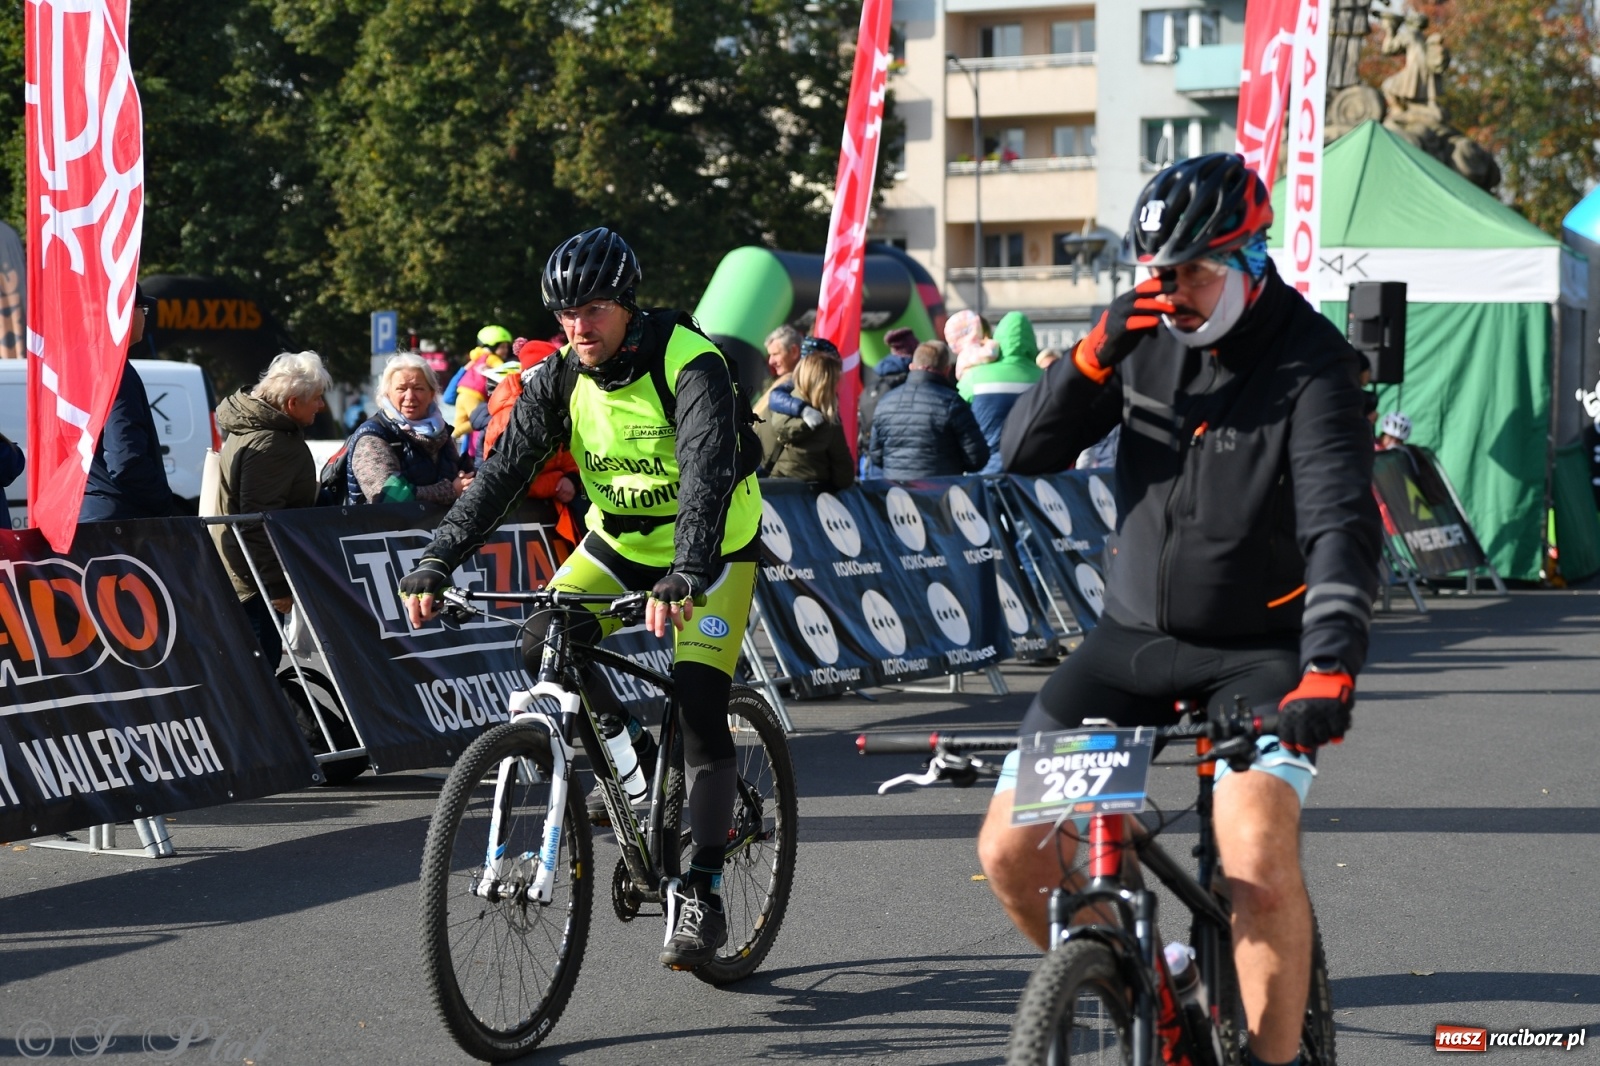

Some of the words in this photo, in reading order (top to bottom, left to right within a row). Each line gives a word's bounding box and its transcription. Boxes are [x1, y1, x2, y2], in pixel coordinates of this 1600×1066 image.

[157, 298, 262, 330] MAXXIS
[378, 316, 392, 349] P
[832, 561, 882, 577] KOKOwear
[900, 554, 947, 570] KOKOwear
[763, 564, 815, 582] KOKOwear
[678, 641, 723, 653] MERIDA
[945, 645, 997, 666] KOKOwear
[881, 657, 929, 675] KOKOwear
[810, 667, 860, 686] KOKOwear
[19, 716, 224, 800] NAJLEPSZYCH
[1034, 751, 1130, 775] OPIEKUN
[1040, 766, 1113, 803] 267
[607, 780, 638, 843] MERIDA
[545, 826, 560, 872] ROCKSHOX
[539, 1018, 550, 1035] CST
[520, 1031, 537, 1048] JACK
